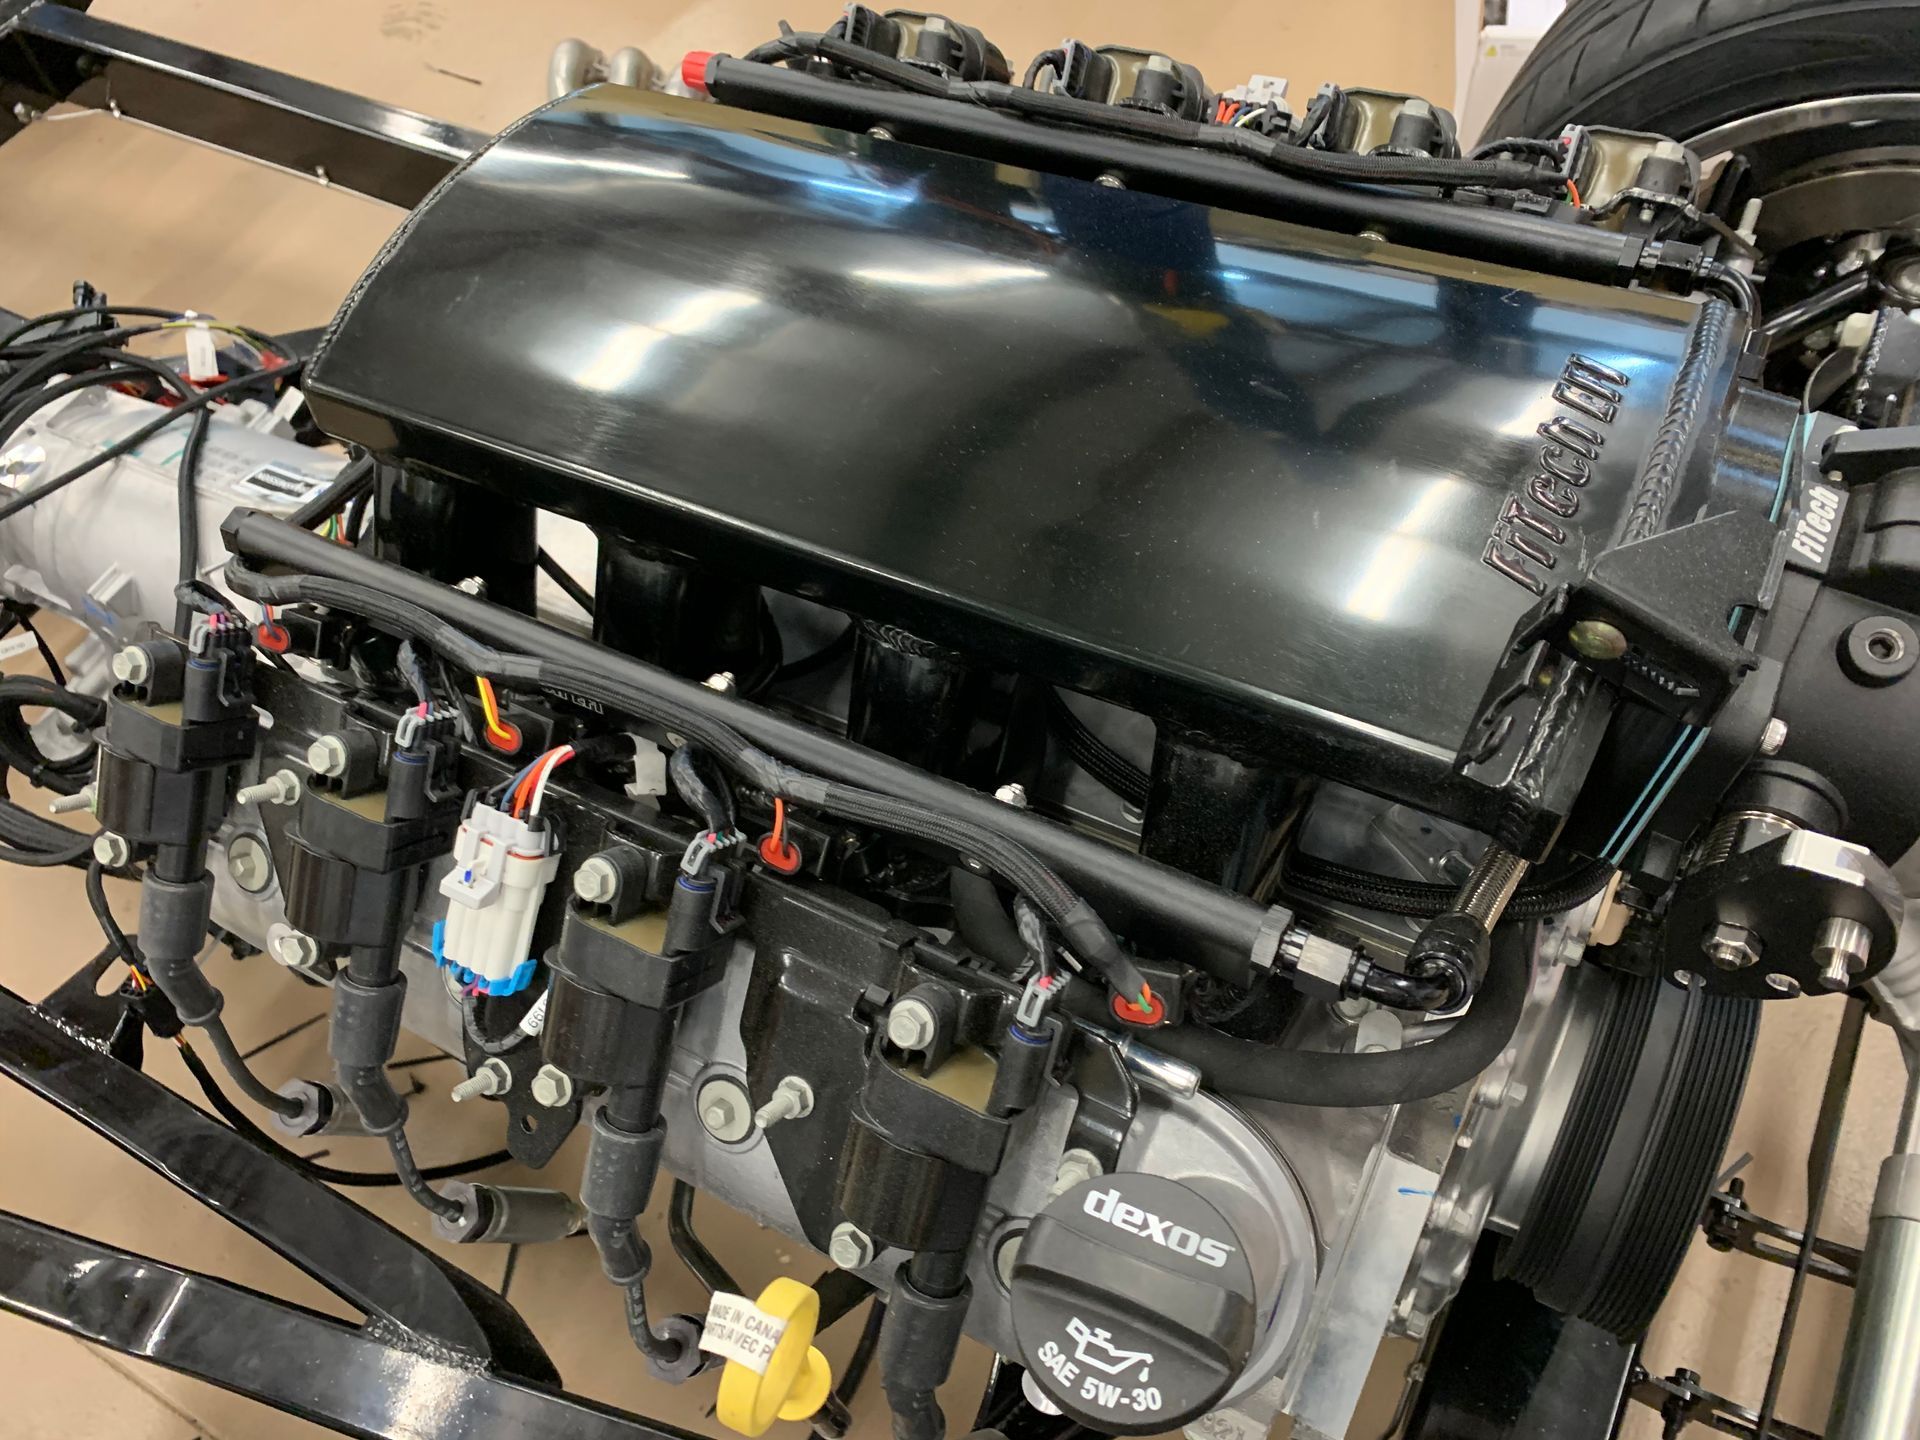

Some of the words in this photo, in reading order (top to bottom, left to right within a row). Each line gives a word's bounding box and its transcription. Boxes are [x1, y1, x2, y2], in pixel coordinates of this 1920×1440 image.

[1791, 486, 1839, 563] FiTech
[1083, 1188, 1233, 1268] dexos
[731, 1309, 744, 1325] IN
[1038, 1341, 1080, 1388] SAE
[1080, 1376, 1162, 1412] 5W-30
